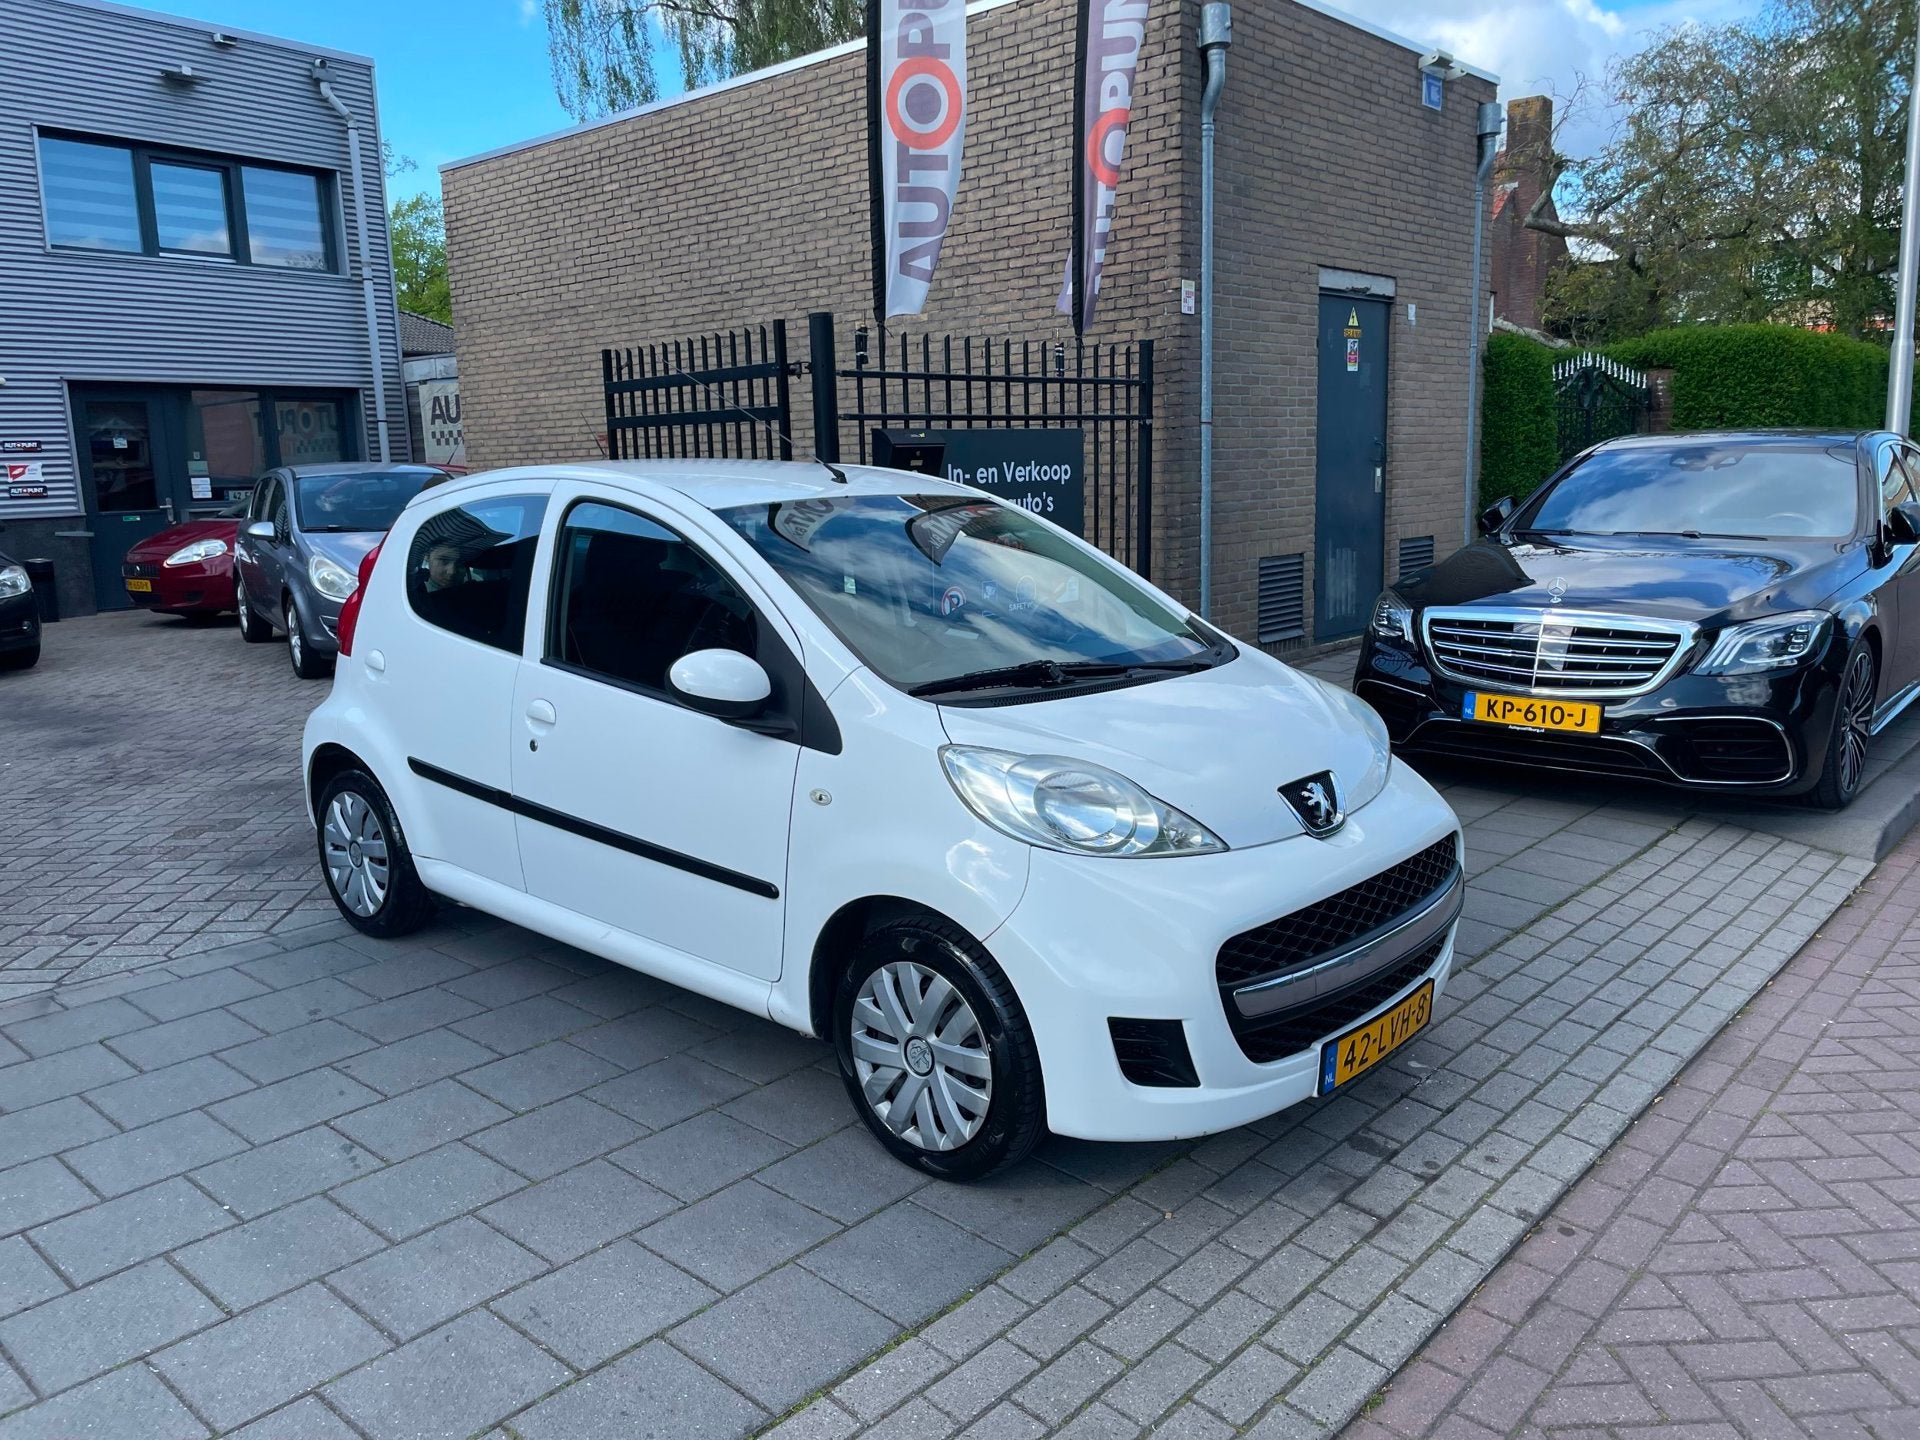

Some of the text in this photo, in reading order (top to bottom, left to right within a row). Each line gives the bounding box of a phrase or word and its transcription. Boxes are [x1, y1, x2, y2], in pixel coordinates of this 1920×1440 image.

[885, 0, 962, 284] AUTOP
[430, 394, 462, 425] AU
[947, 460, 1072, 485] In- en Verkoop
[1464, 698, 1587, 728] NL KP-610-J
[1324, 993, 1427, 1086] NL 42-LVH-8
